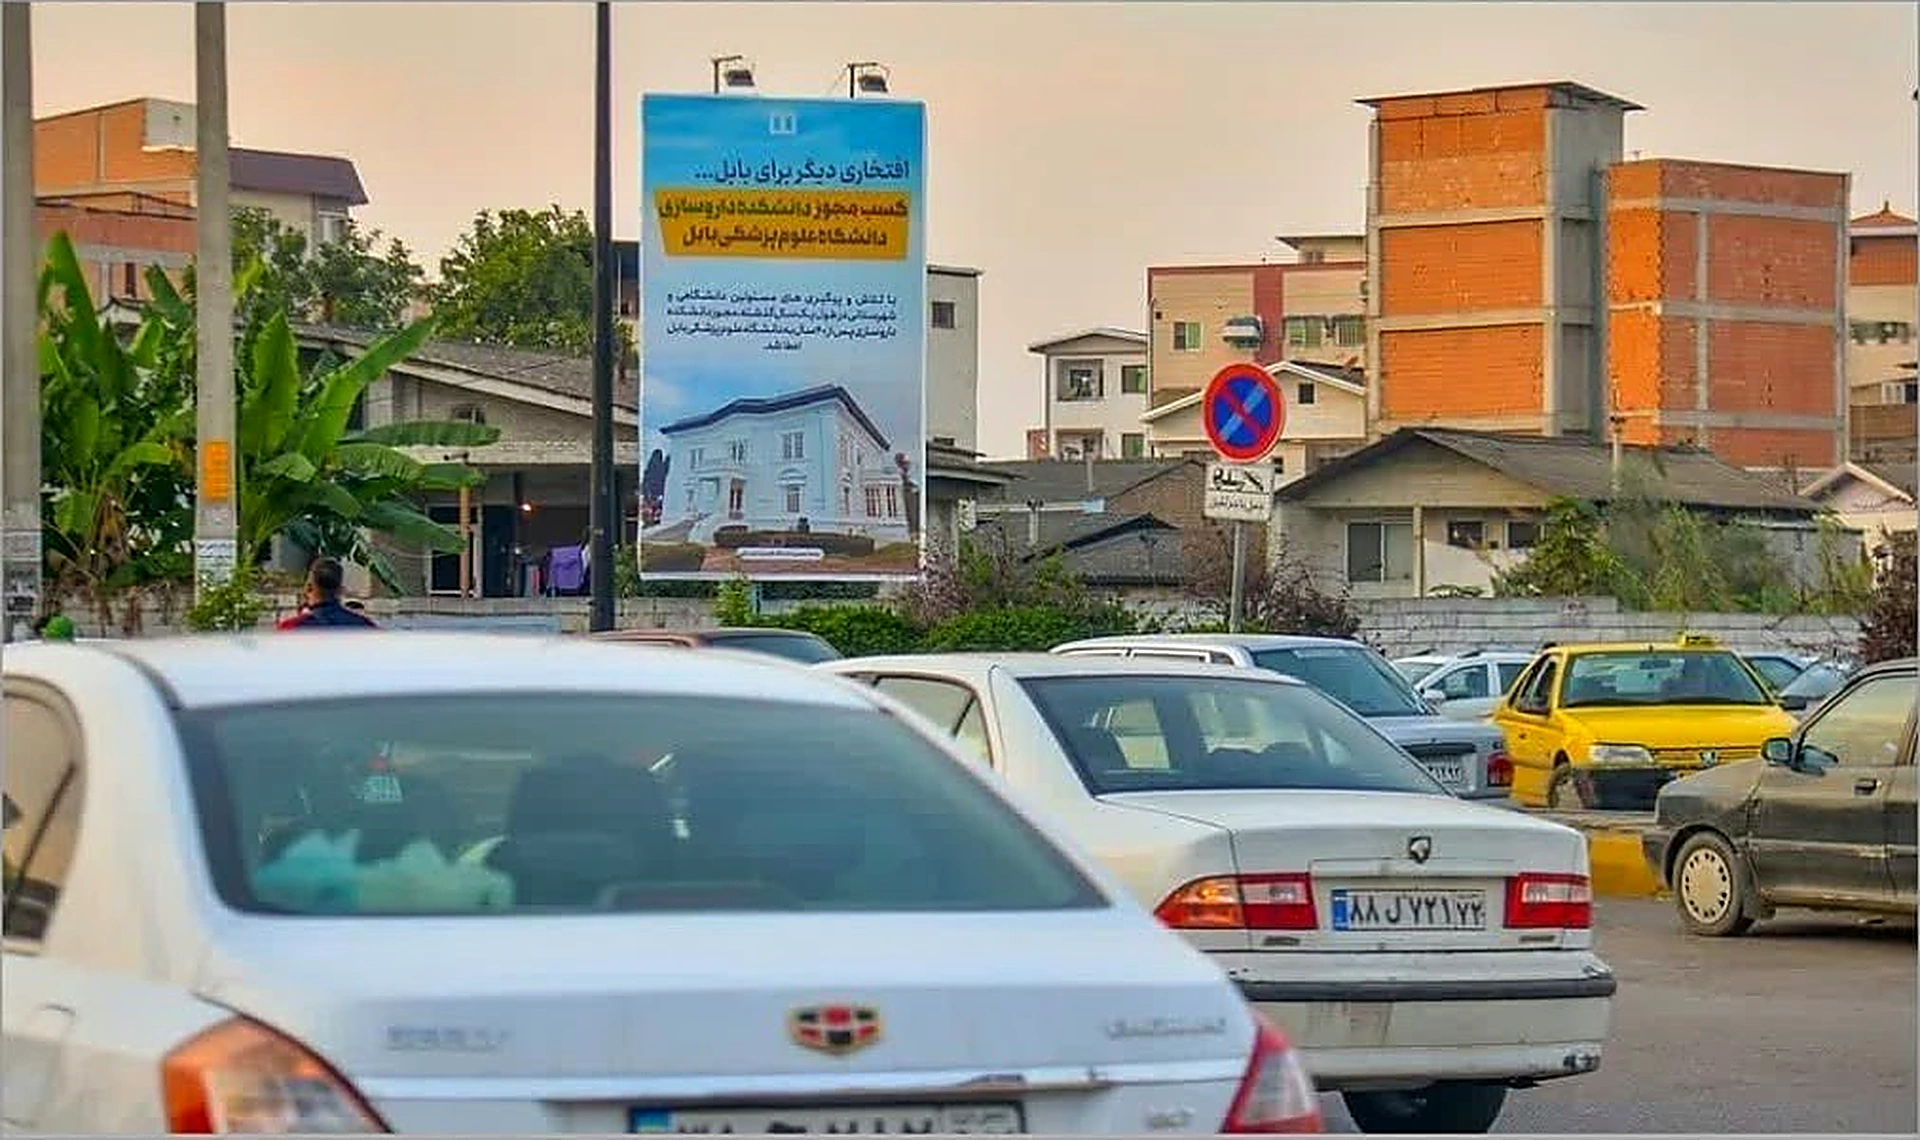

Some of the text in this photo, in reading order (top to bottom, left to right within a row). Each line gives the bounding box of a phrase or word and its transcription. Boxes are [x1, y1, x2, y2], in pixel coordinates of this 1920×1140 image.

[754, 157, 793, 185] برای
[795, 159, 836, 185] دیگر
[841, 159, 909, 185] افتخاری
[659, 197, 908, 221] کسب مجوز دانشکده داروسازی
[682, 224, 887, 251] دانشگاه علوم پزشکی بابل
[846, 297, 853, 307] و
[886, 293, 896, 308] با
[1350, 895, 1379, 923] ۸۸
[1408, 896, 1451, 925] ۷۲۱
